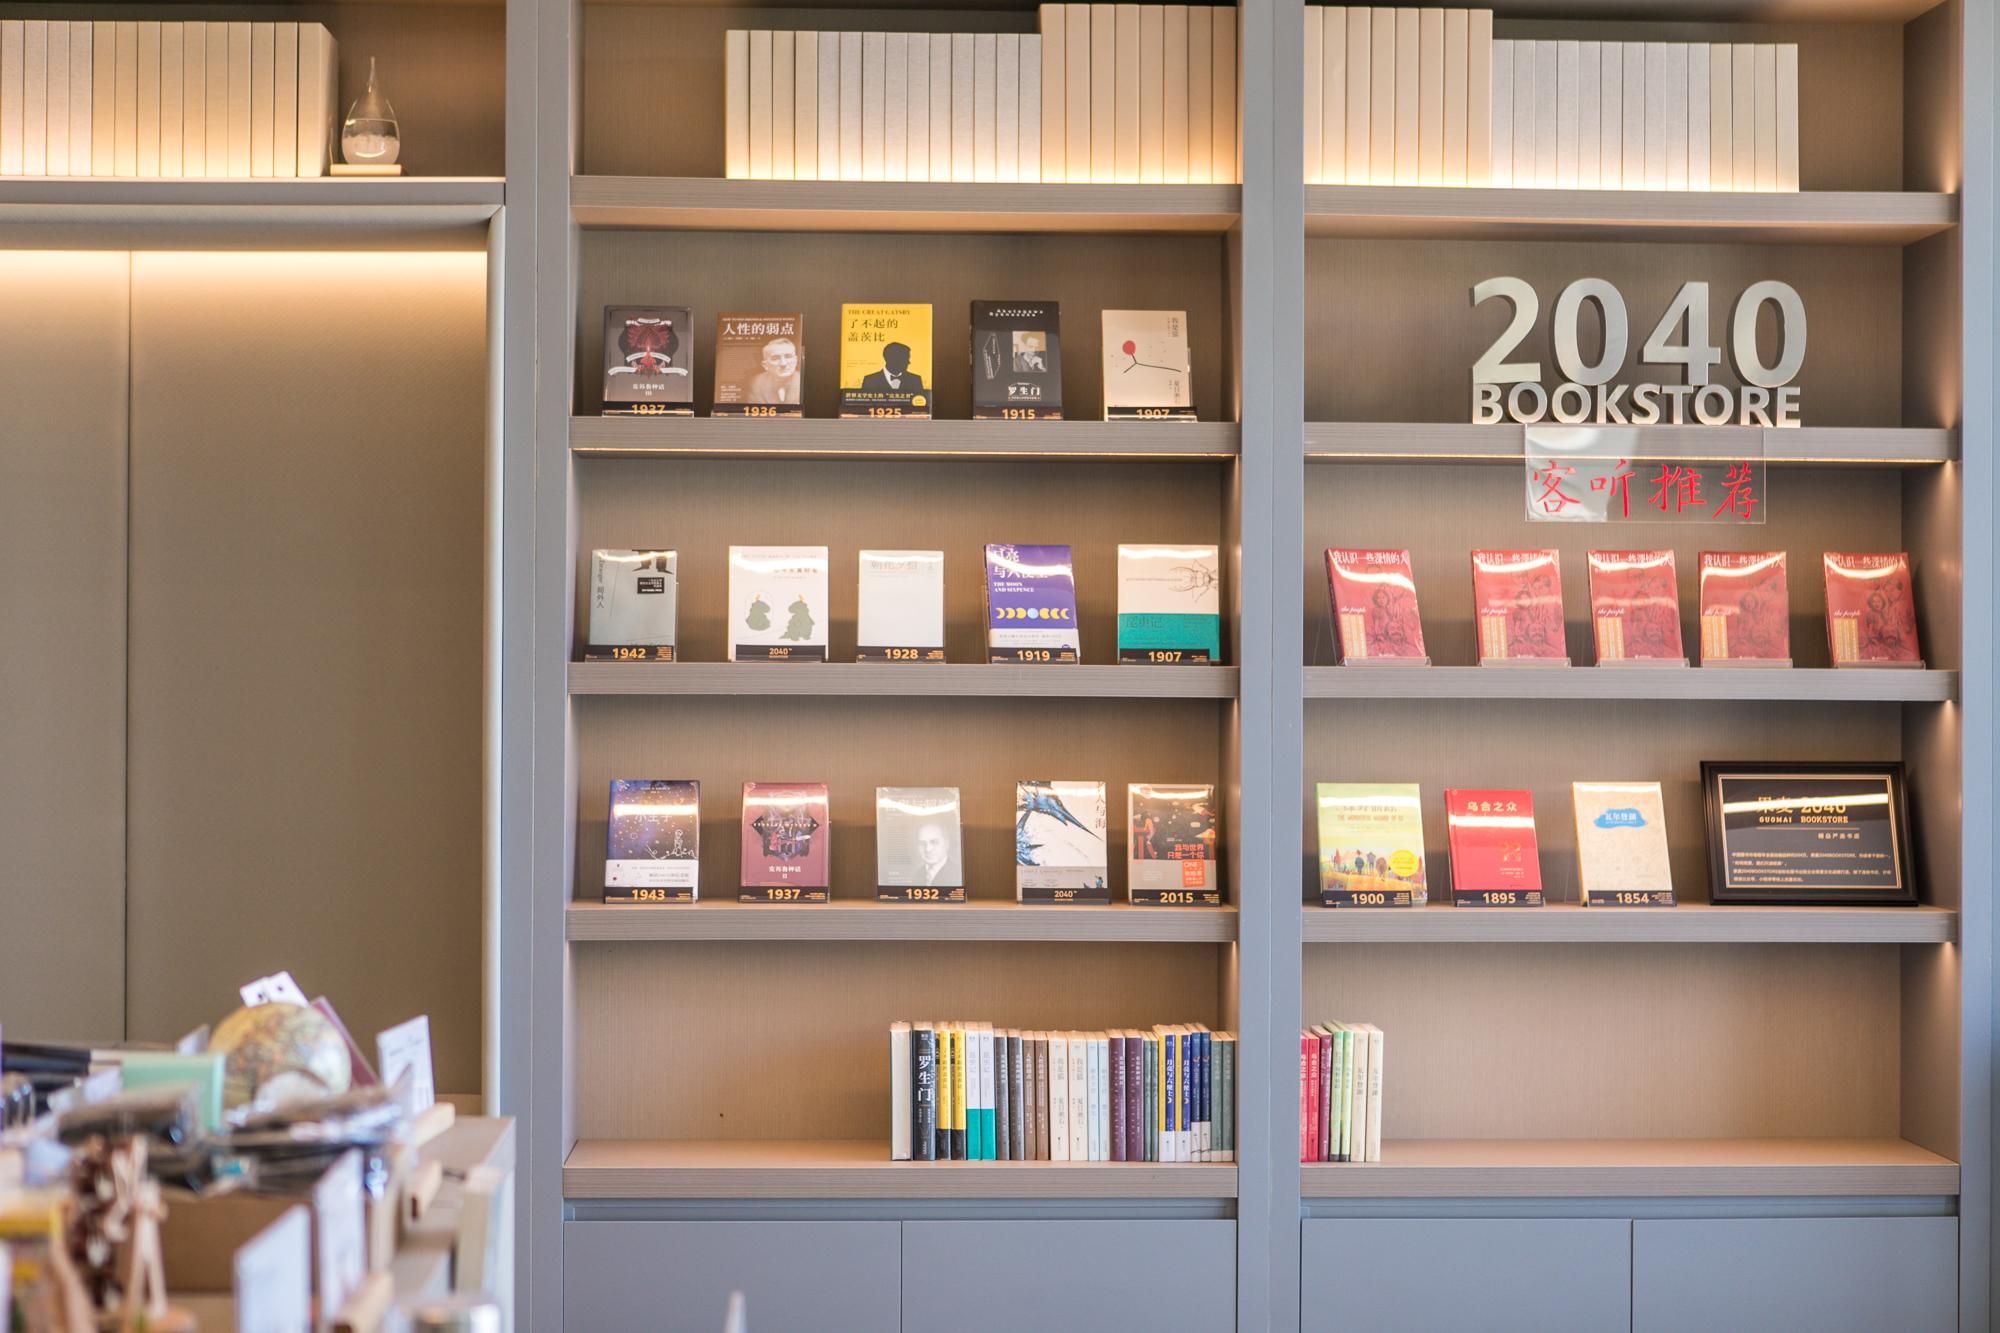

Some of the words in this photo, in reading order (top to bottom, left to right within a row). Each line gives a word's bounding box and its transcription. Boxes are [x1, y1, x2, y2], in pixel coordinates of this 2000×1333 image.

[722, 322, 795, 335] 人性的弱点
[848, 318, 899, 329] 了不起的
[848, 332, 885, 343] 盖茨比
[1472, 276, 1807, 389] 2040
[631, 404, 666, 415] 1937
[1472, 382, 1801, 428] BOOKSTORE
[743, 406, 777, 417] 1936
[868, 407, 902, 419] 1925
[1001, 408, 1036, 420] 1915
[1136, 408, 1170, 420] 1907
[1533, 458, 1758, 520] 客听推荐
[612, 647, 646, 659] 1942
[884, 648, 919, 660] 1928
[1017, 650, 1051, 661] 1919
[1148, 651, 1182, 663] 1907
[1467, 801, 1518, 812] 乌合之众
[1800, 815, 1849, 824] BOOKSTORE
[631, 889, 665, 900] 1943
[767, 888, 801, 900] 1937
[905, 888, 940, 900] 1932
[1159, 892, 1194, 903] 2015
[1351, 893, 1385, 904] 1900
[1482, 892, 1517, 904] 1895
[1615, 892, 1650, 904] 1854
[918, 1055, 932, 1101] 罗生门
